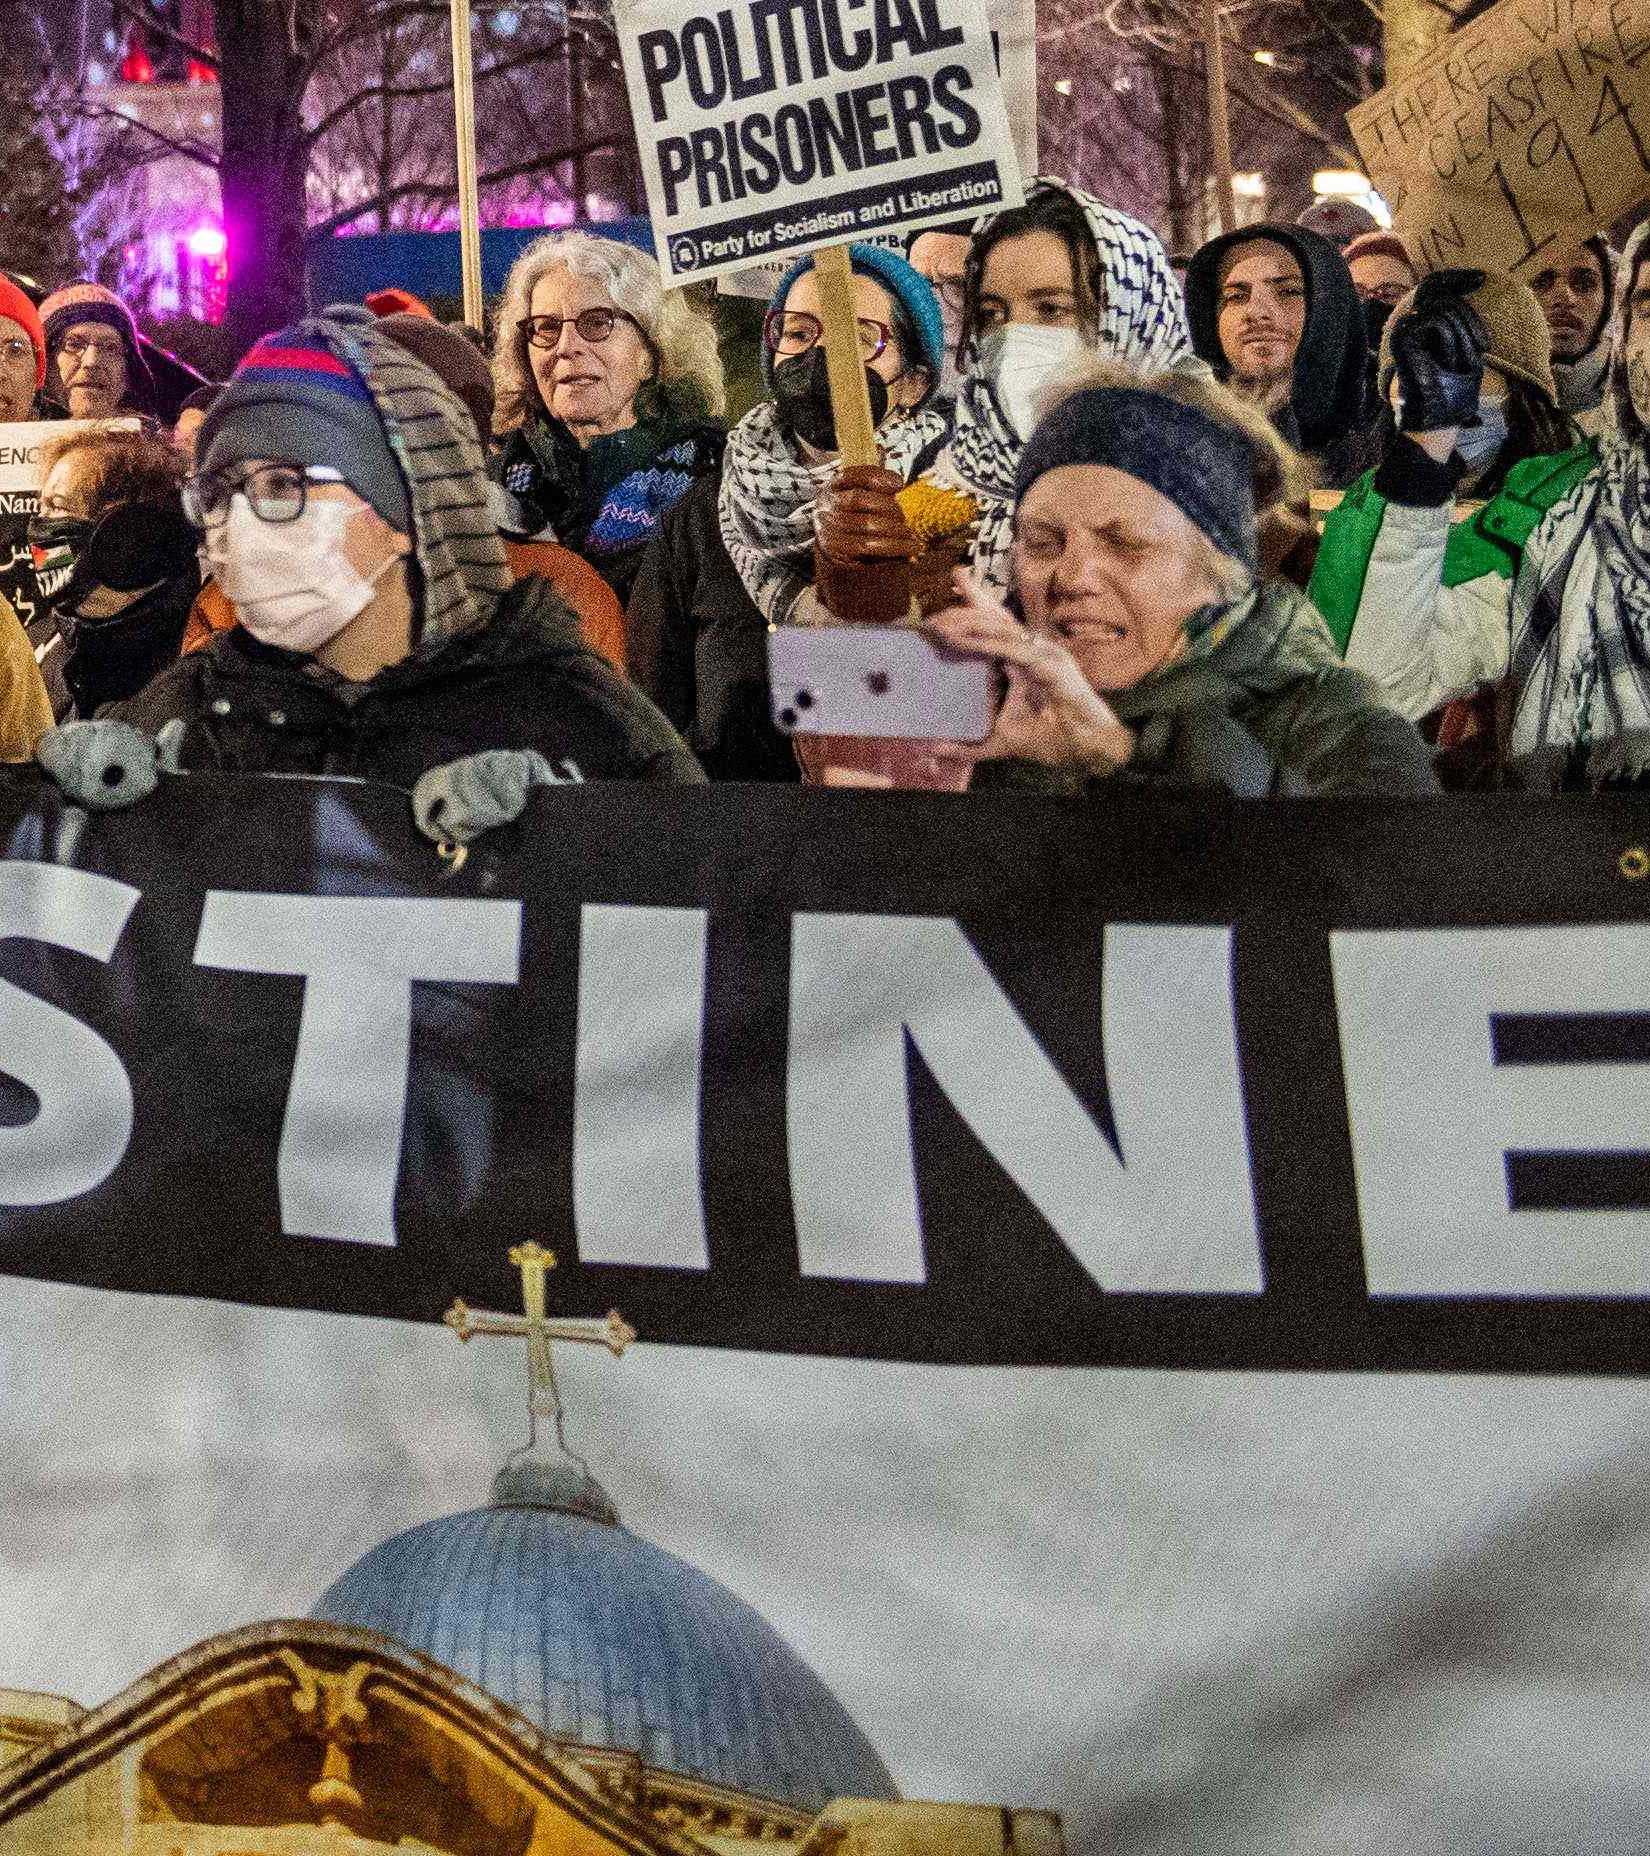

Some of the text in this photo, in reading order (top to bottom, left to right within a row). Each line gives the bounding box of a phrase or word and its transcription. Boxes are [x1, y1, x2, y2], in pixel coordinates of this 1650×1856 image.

[656, 65, 982, 217] PRISONERS
[1360, 38, 1503, 154] THERE
[702, 235, 744, 260] Party
[747, 227, 772, 249] for
[774, 208, 855, 242] Socialism
[859, 203, 895, 223] and
[900, 177, 998, 214] Liberation
[1483, 75, 1650, 271] 194
